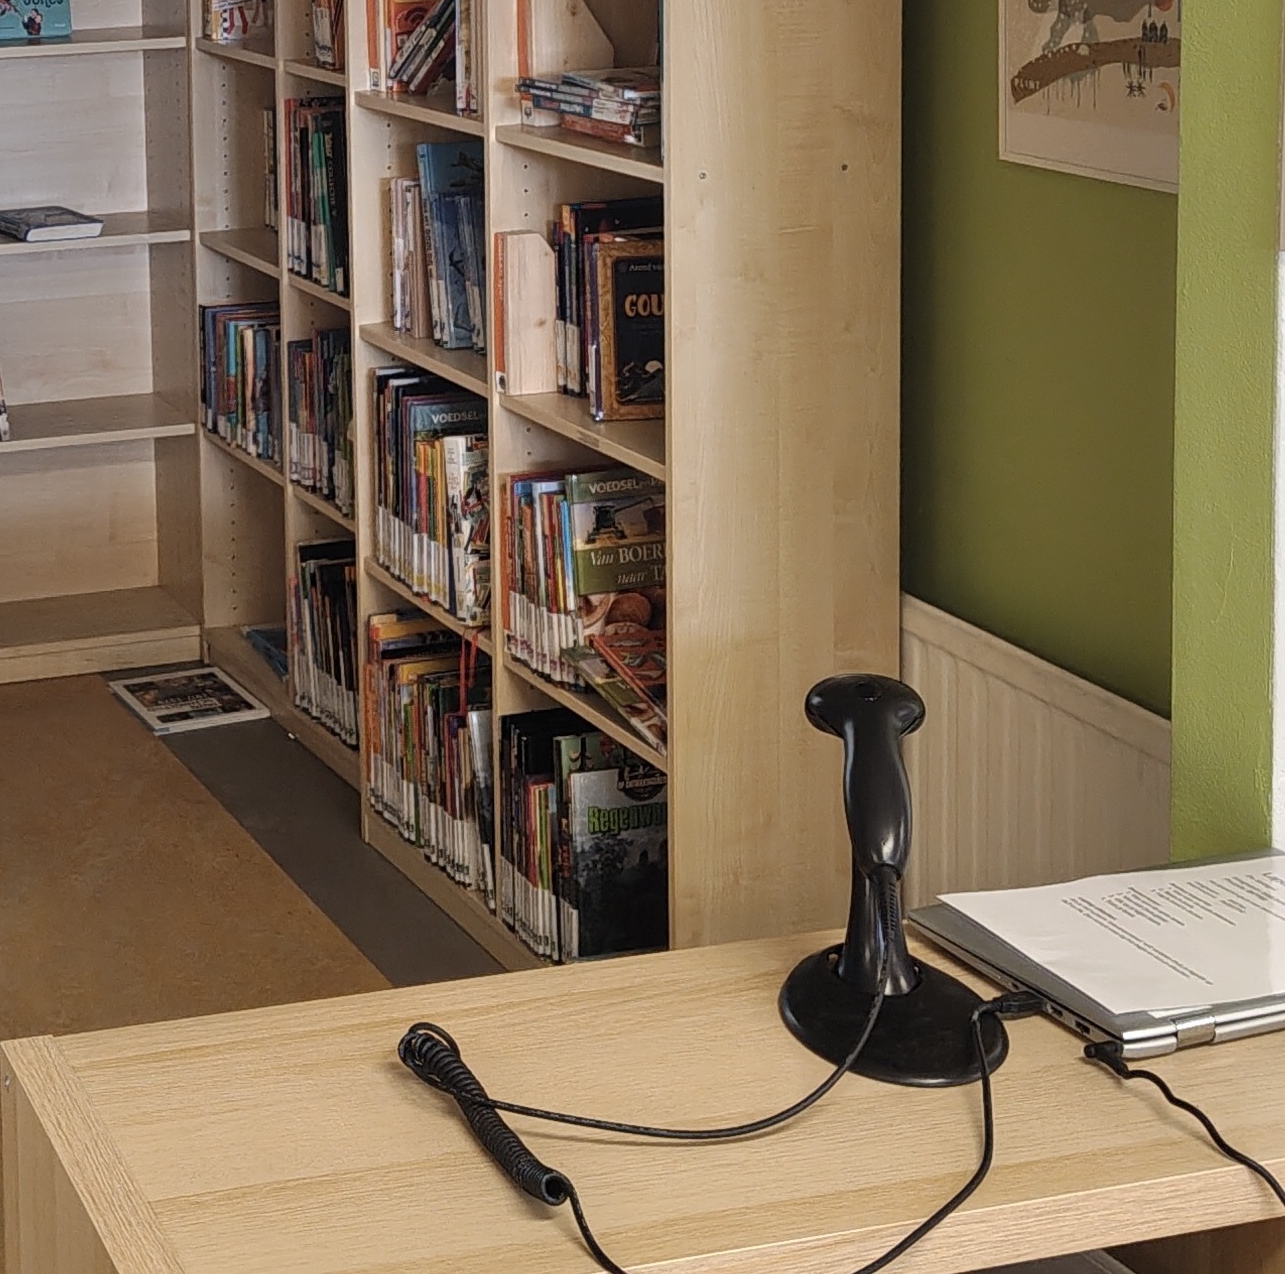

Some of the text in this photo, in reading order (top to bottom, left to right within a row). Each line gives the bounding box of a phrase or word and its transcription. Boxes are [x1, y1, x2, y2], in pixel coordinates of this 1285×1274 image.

[625, 293, 664, 317] GOU
[431, 411, 479, 425] VOEDSEL
[588, 479, 639, 494] VOEDSEL
[588, 803, 666, 835] Regenwo
